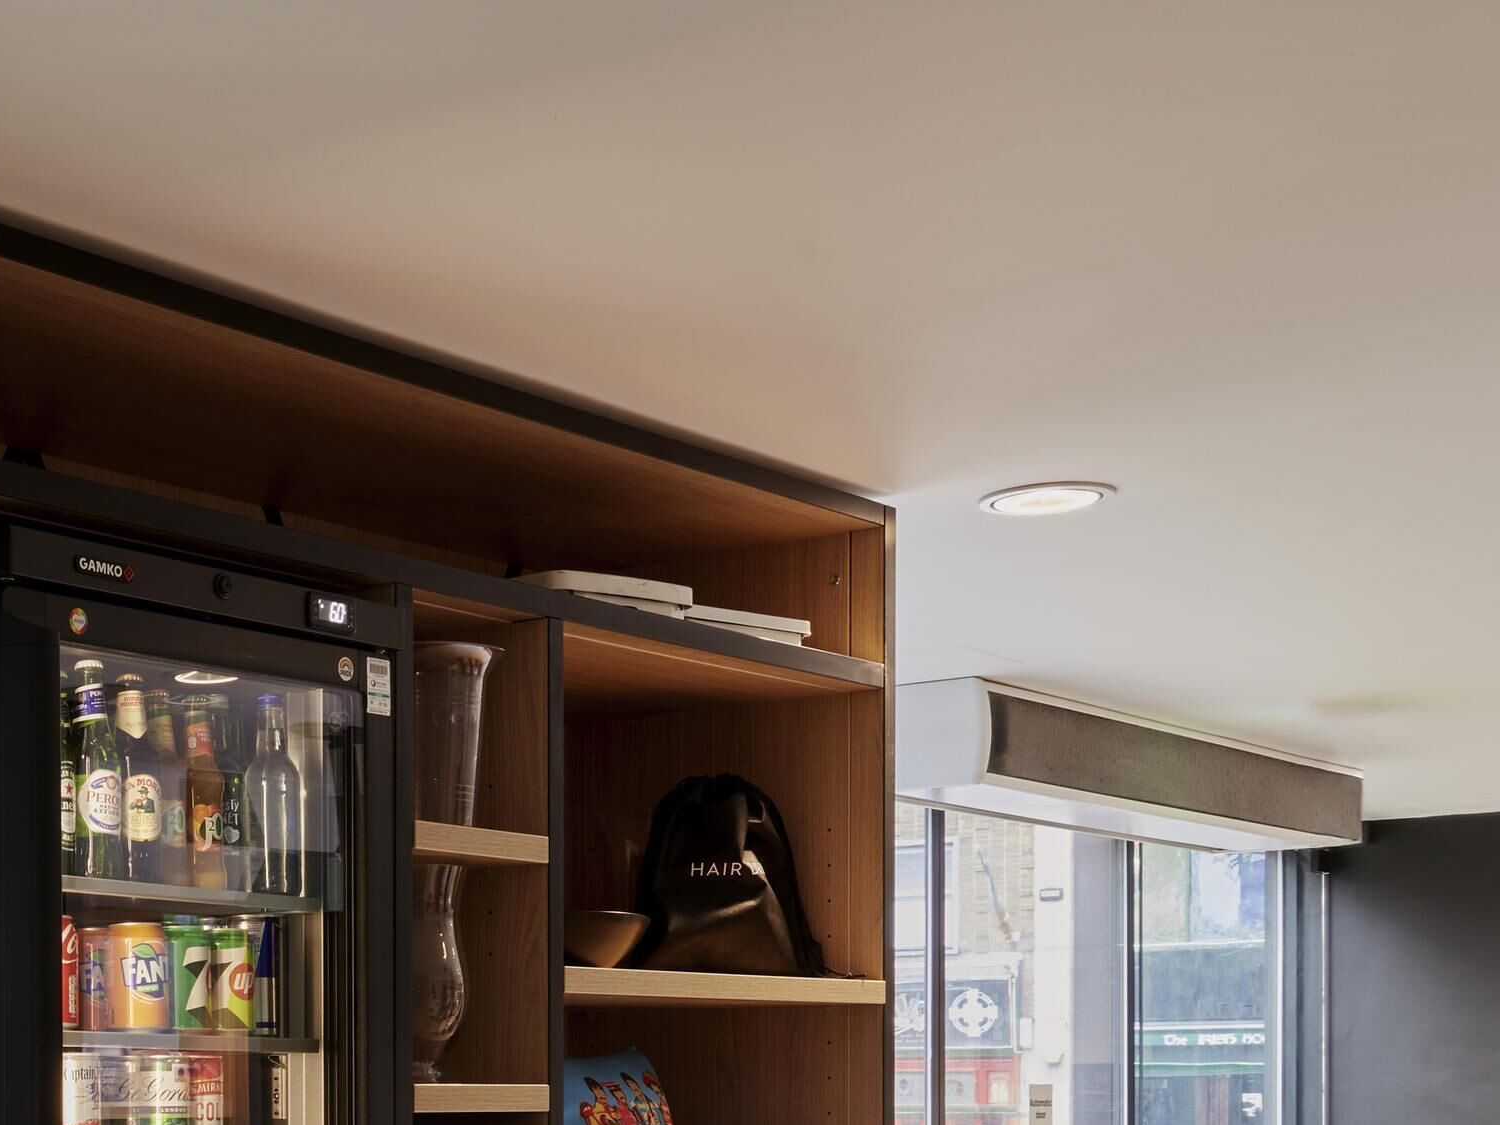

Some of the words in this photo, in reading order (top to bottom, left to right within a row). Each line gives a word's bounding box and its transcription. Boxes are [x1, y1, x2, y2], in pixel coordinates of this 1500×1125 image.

[79, 557, 122, 578] GAMKO
[690, 862, 742, 877] HAIR
[1029, 1099, 1053, 1107] Automatic
